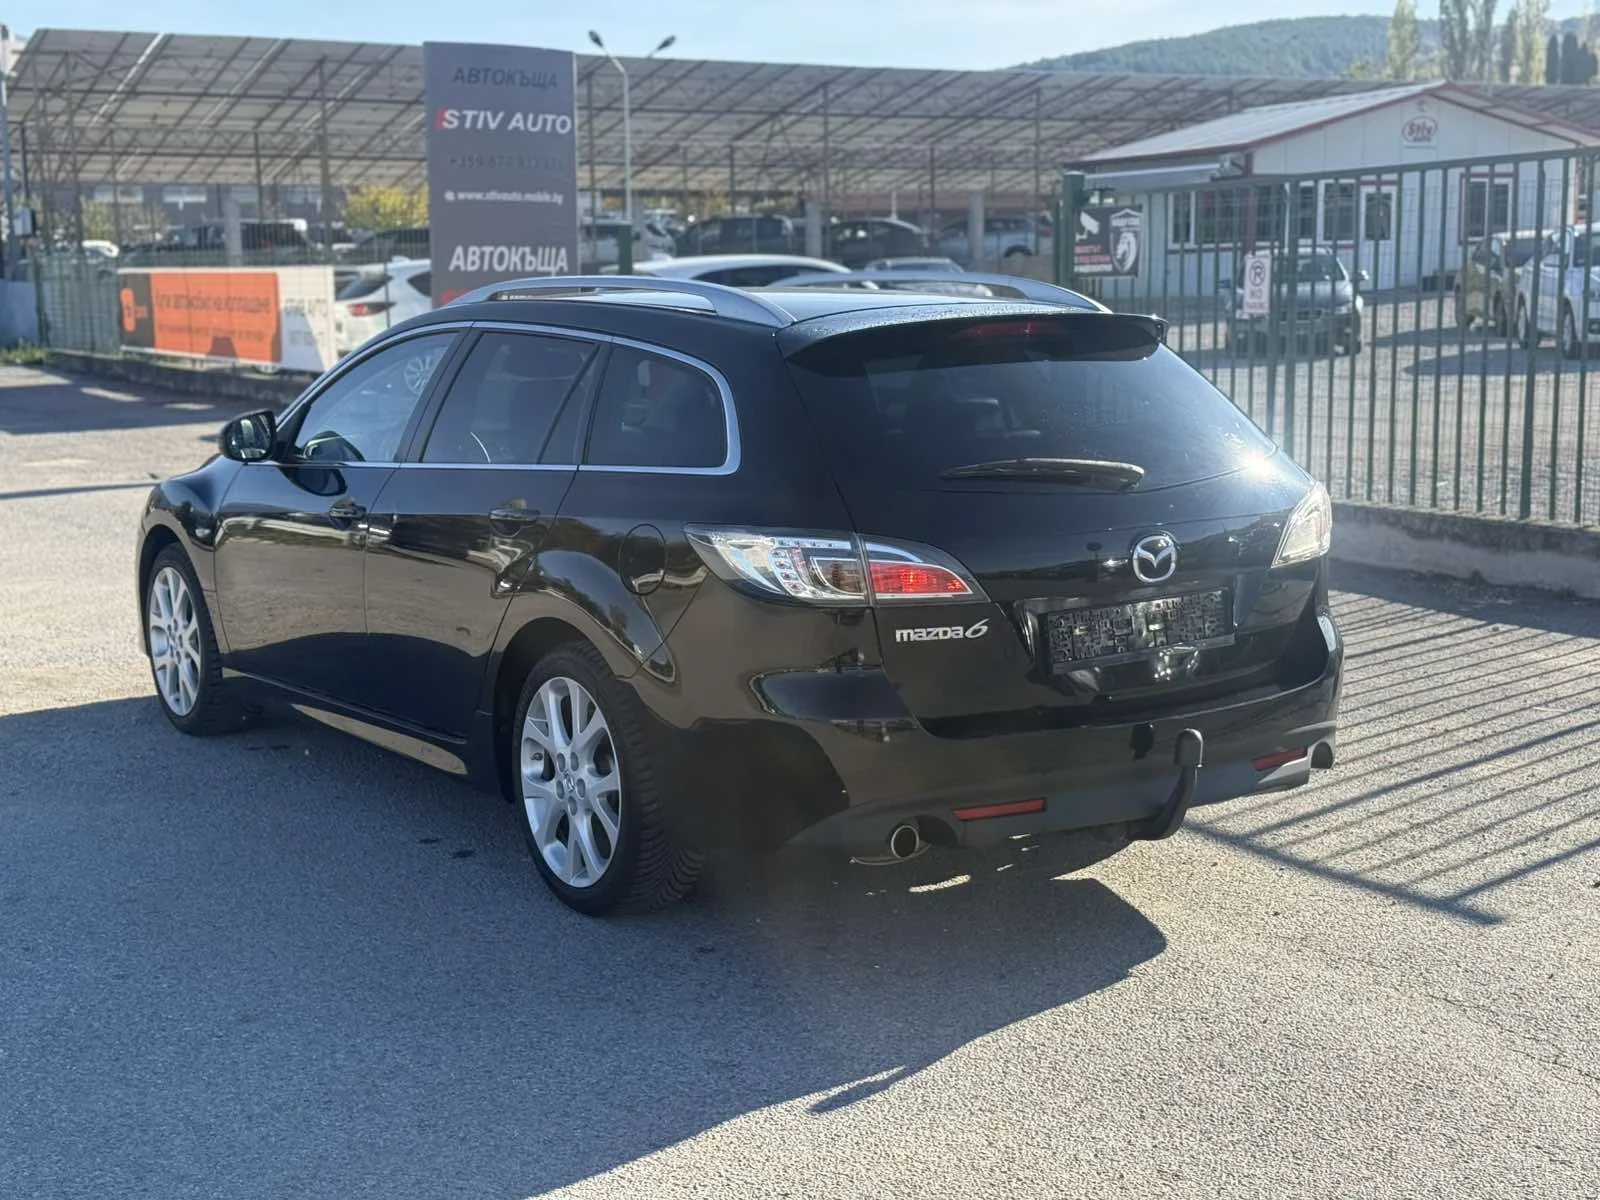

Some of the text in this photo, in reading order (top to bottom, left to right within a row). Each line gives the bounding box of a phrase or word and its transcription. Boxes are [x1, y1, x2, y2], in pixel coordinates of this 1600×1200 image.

[452, 66, 559, 91] АВТОКЪЩА
[440, 108, 572, 135] STIV AUTO
[448, 245, 568, 276] АВТОКЪЩА
